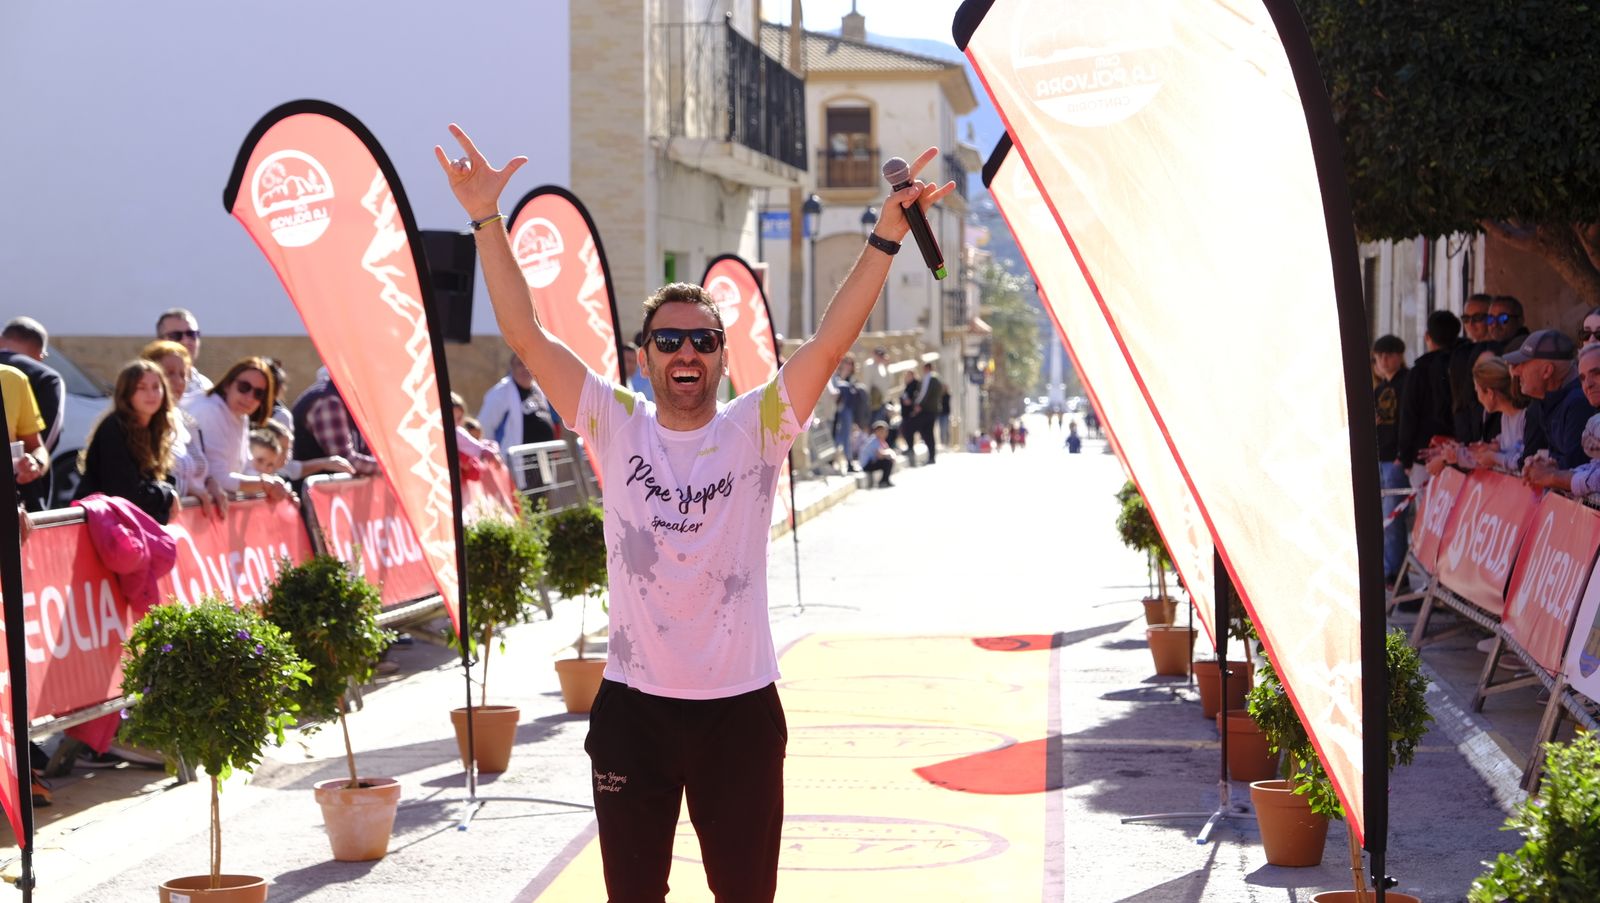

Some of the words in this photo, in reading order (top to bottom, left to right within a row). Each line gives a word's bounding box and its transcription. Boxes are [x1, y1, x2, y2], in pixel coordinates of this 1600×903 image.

[626, 455, 671, 501] Pepe
[357, 516, 424, 571] VEOLI
[1465, 511, 1518, 578] VEOLIA
[1532, 544, 1586, 627] VEOLIA
[23, 578, 127, 664] EOLIA
